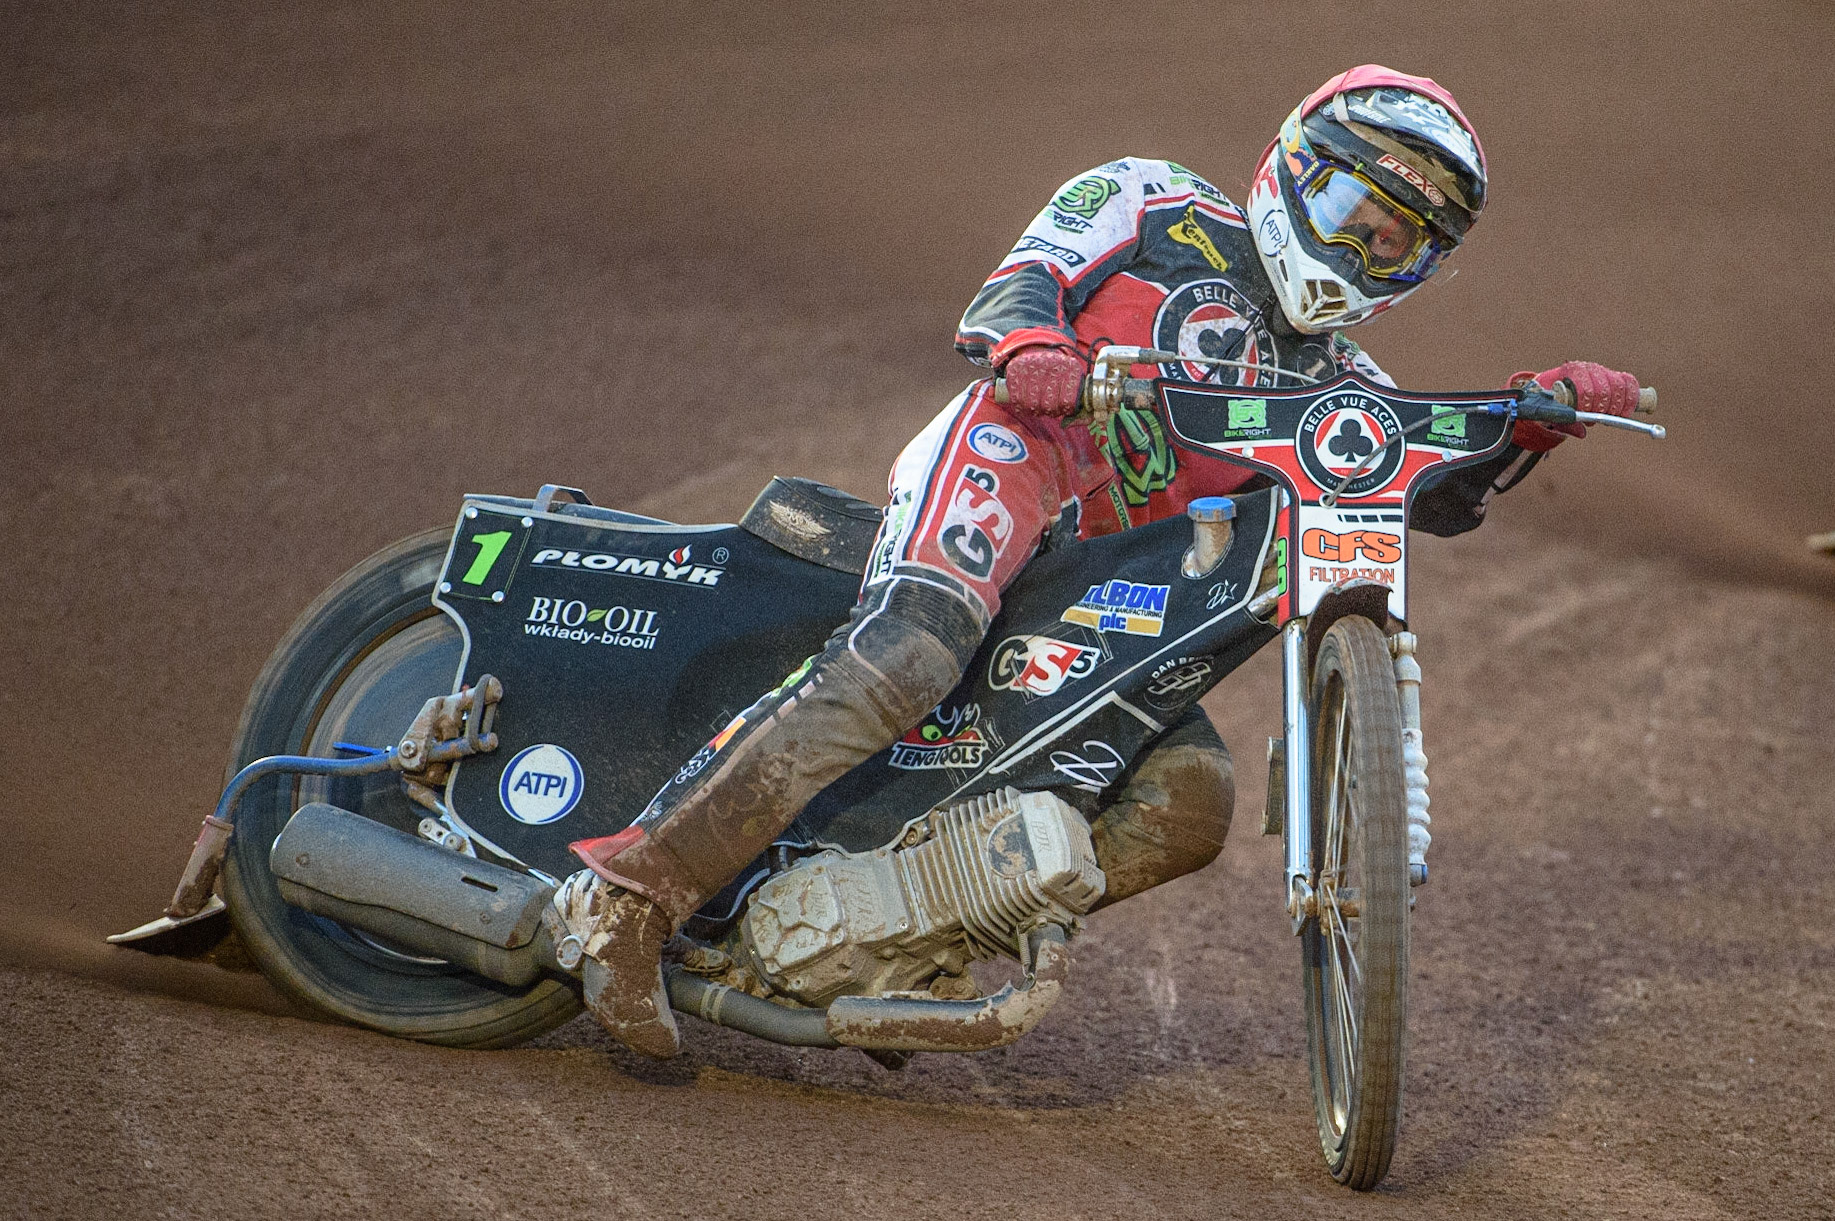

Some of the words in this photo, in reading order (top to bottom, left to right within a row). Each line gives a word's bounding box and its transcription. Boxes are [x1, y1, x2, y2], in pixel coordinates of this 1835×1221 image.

[1380, 155, 1434, 192] FLEX
[1266, 220, 1284, 248] ATPI
[1017, 237, 1079, 263] ETARD
[1192, 285, 1239, 308] BELLE
[1304, 400, 1336, 433] BELLE
[1340, 396, 1368, 410] VUE
[1371, 406, 1397, 435] ACES
[978, 431, 1017, 453] ATPI
[462, 530, 512, 586] 1
[1302, 528, 1401, 564] CFS
[1309, 566, 1395, 584] FILTRATION
[1099, 613, 1127, 631] plc
[1151, 659, 1176, 679] DAN
[513, 771, 567, 798] ATPI
